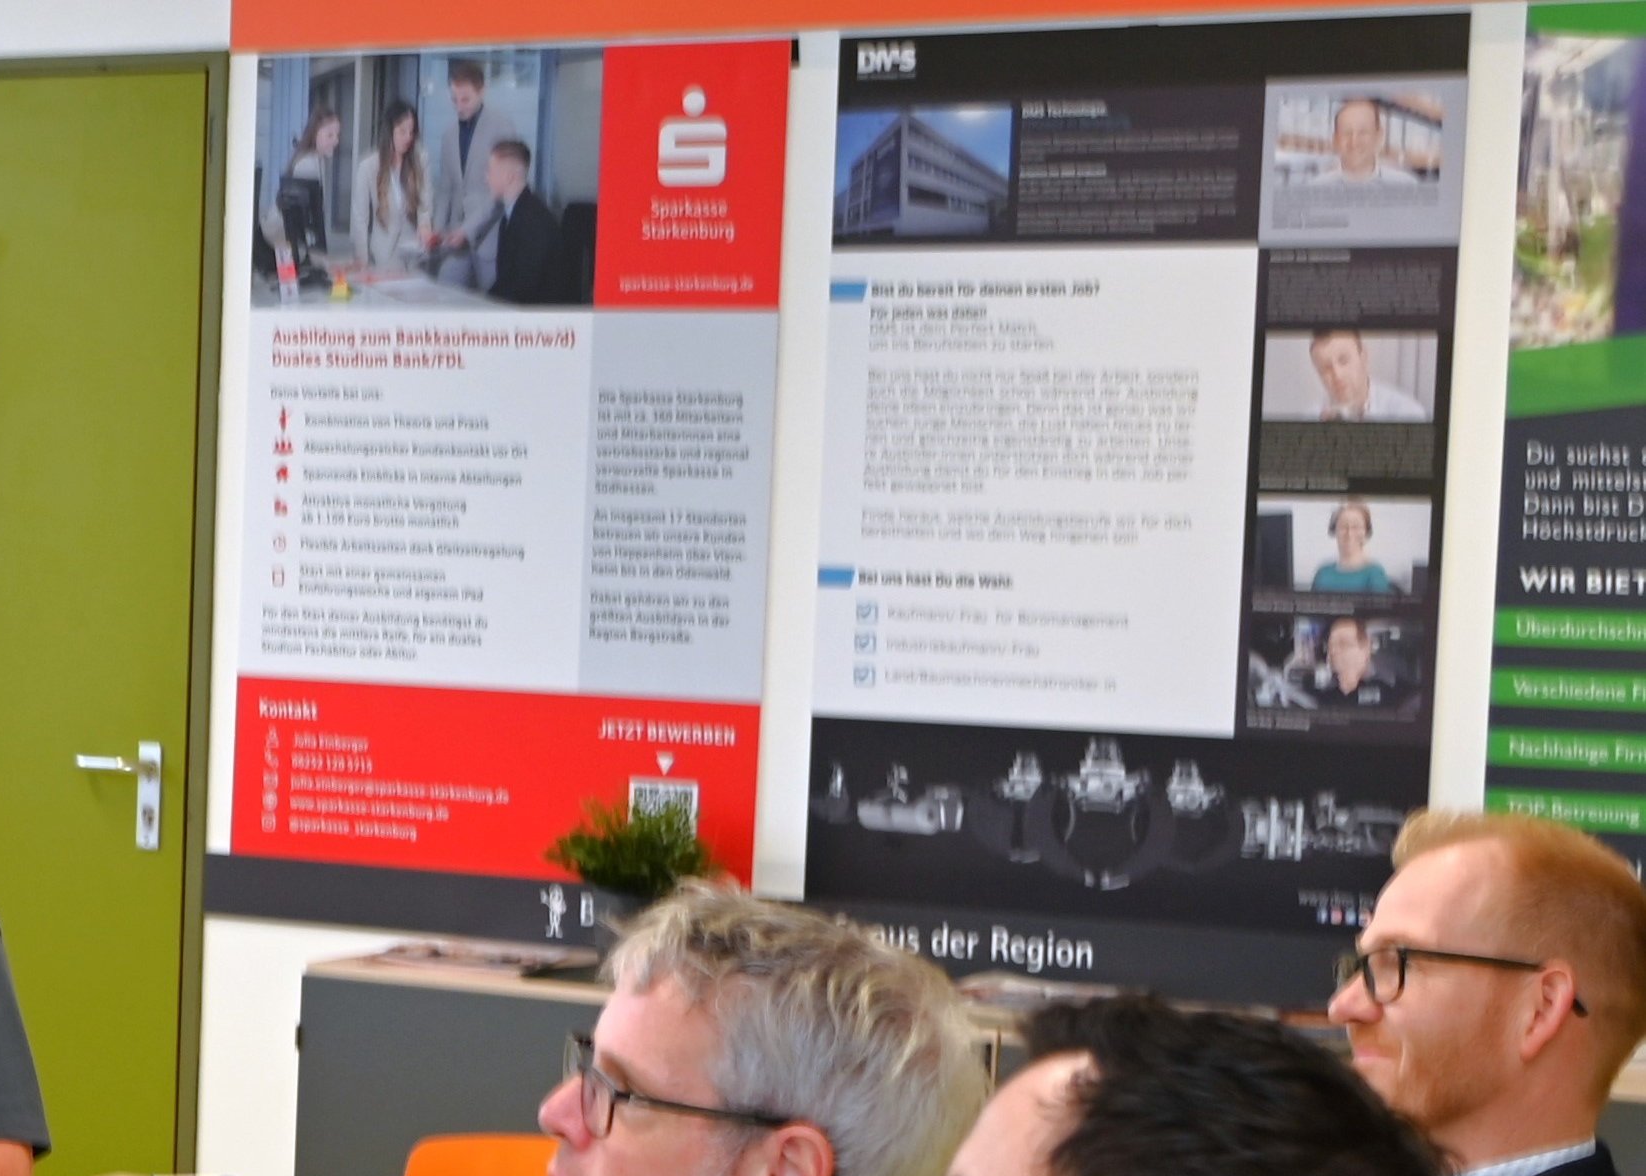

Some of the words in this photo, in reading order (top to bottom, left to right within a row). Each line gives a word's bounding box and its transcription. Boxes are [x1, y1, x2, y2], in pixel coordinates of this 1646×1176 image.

[651, 196, 727, 223] Sparkasse
[641, 218, 735, 243] Starkenburg
[871, 280, 895, 298] Bist
[898, 279, 914, 298] du
[916, 279, 954, 298] bereit
[957, 279, 976, 298] für
[979, 279, 1023, 298] deinen
[1025, 280, 1067, 299] ersten
[1070, 277, 1101, 299] Job?
[926, 307, 948, 321] was
[273, 328, 355, 349] Ausbildung
[360, 331, 391, 346] zum
[395, 328, 508, 347] Bankkaufmann
[514, 328, 575, 350] (m/w/d)
[272, 352, 321, 369] Duales
[326, 352, 388, 369] Studium
[393, 351, 465, 370] Bank/FDL
[300, 385, 341, 401] Vorteile
[598, 389, 617, 405] Die
[619, 390, 674, 407] Sparkasse
[675, 390, 744, 409] Starkenburg
[434, 415, 455, 430] und
[597, 409, 611, 423] ist
[612, 409, 631, 423] mit
[675, 409, 744, 424] Mitarbeitern
[597, 428, 618, 441] und
[621, 427, 714, 441] Mitarbeiterinnen
[716, 429, 741, 442] eine
[679, 446, 701, 459] und
[703, 446, 749, 463] regional
[1526, 439, 1555, 466] Du
[1566, 442, 1630, 466] suchst
[662, 465, 719, 480] Sparkasse
[722, 465, 733, 479] in
[1524, 467, 1561, 490] und
[1524, 491, 1575, 516] Dann
[1583, 492, 1620, 517] bist
[594, 507, 608, 521] An
[610, 510, 666, 526] insgesamt
[684, 511, 747, 526] Standorten
[592, 527, 642, 541] betreuen
[663, 530, 700, 544] unsere
[702, 529, 746, 544] Kunden
[592, 546, 611, 560] von
[614, 545, 684, 563] Heppenheim
[685, 547, 711, 562] über
[591, 562, 619, 577] heim
[621, 564, 638, 577] bis
[652, 565, 673, 579] den
[858, 569, 878, 586] Bei
[880, 571, 902, 587] uns
[905, 569, 932, 588] hast
[955, 571, 975, 590] die
[1519, 566, 1576, 594] WIR
[1586, 567, 1646, 596] BIET
[590, 589, 622, 605] Dabei
[624, 590, 670, 608] gehören
[708, 593, 729, 609] den
[589, 609, 633, 627] größten
[711, 612, 730, 628] der
[1515, 612, 1646, 643] Überdurchschn
[588, 625, 627, 642] Region
[1512, 674, 1626, 703] Verschiedene
[259, 698, 318, 721] Kontakt
[599, 717, 644, 741] JETZT
[647, 720, 735, 746] BEWERBEN
[1509, 733, 1609, 766] Nachhaltige
[931, 921, 979, 960] der
[990, 926, 1093, 973] Region
